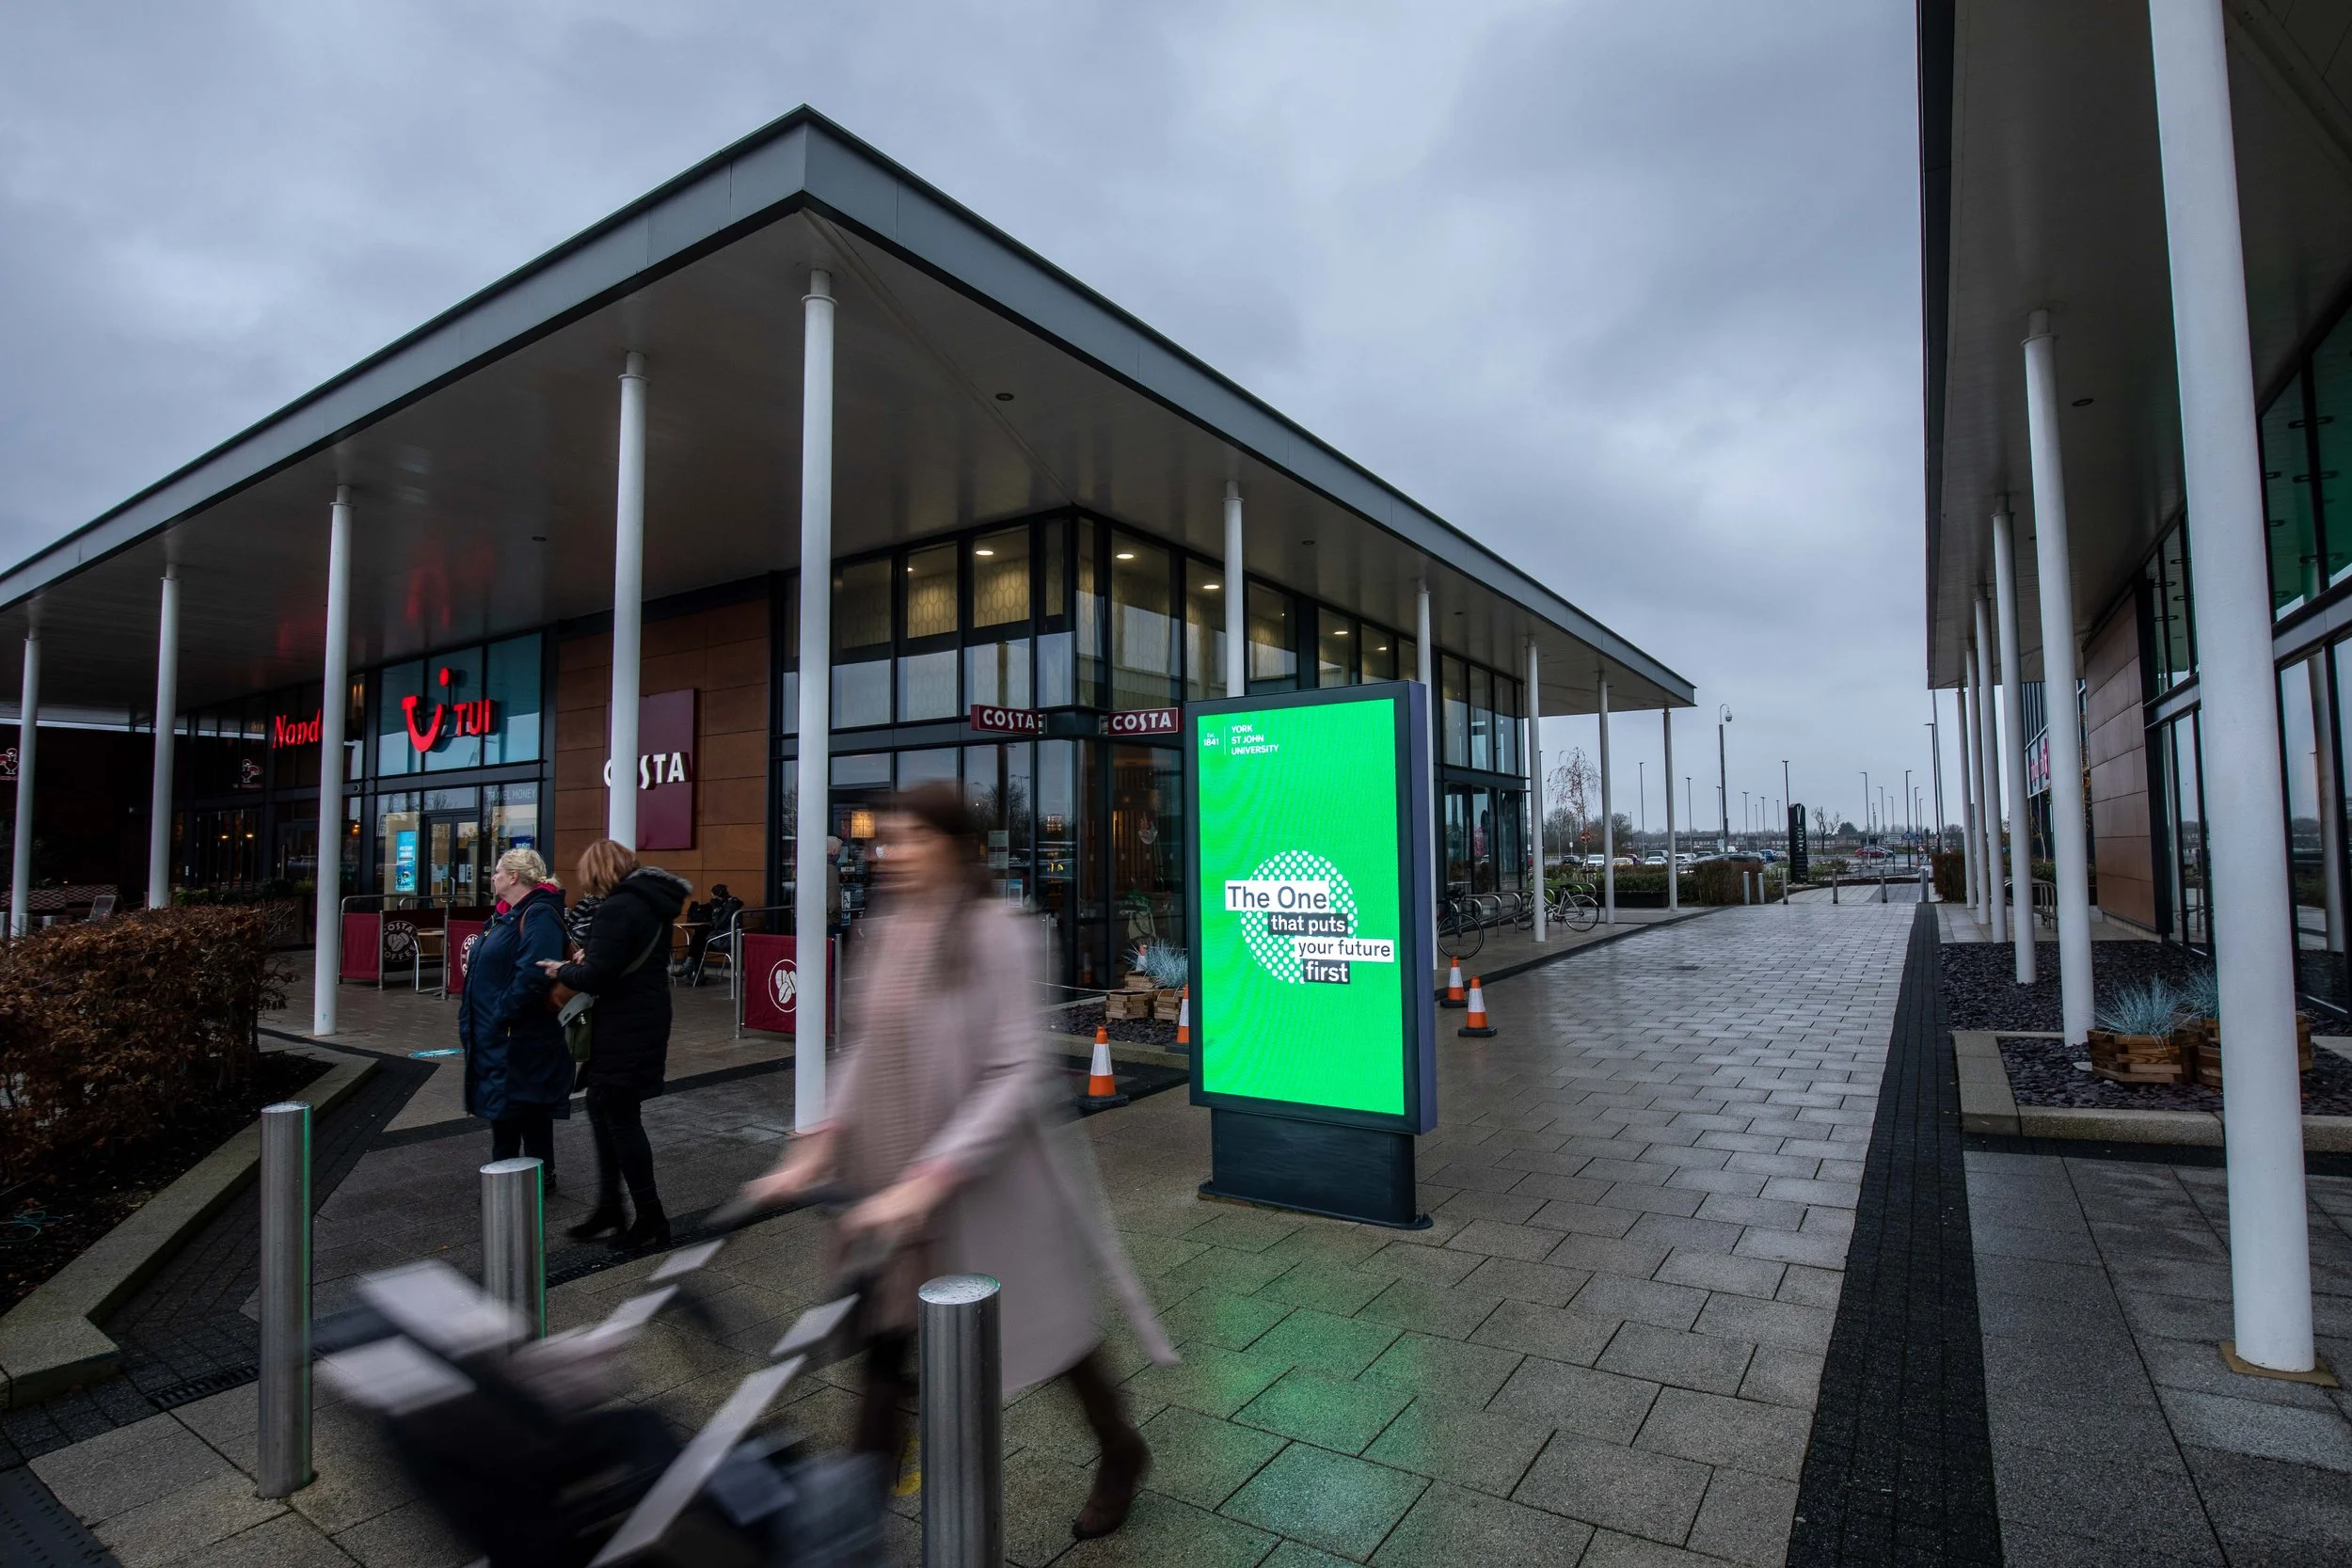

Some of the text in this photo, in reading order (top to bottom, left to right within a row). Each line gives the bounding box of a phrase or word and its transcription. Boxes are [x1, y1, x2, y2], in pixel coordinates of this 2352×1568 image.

[453, 699, 492, 736] TUI
[982, 708, 1035, 729] COSTA
[1112, 712, 1172, 732] COSTA
[273, 707, 323, 750] Nand
[1232, 724, 1252, 734] YORK
[1243, 734, 1264, 744] JOHN
[1231, 744, 1279, 755] UNIVERSITY
[604, 752, 686, 790] CSTA
[512, 788, 536, 800] MONEY
[1228, 886, 1327, 910] The One
[1271, 914, 1346, 935] that puts
[1298, 940, 1391, 957] your future
[1306, 960, 1348, 982] first
